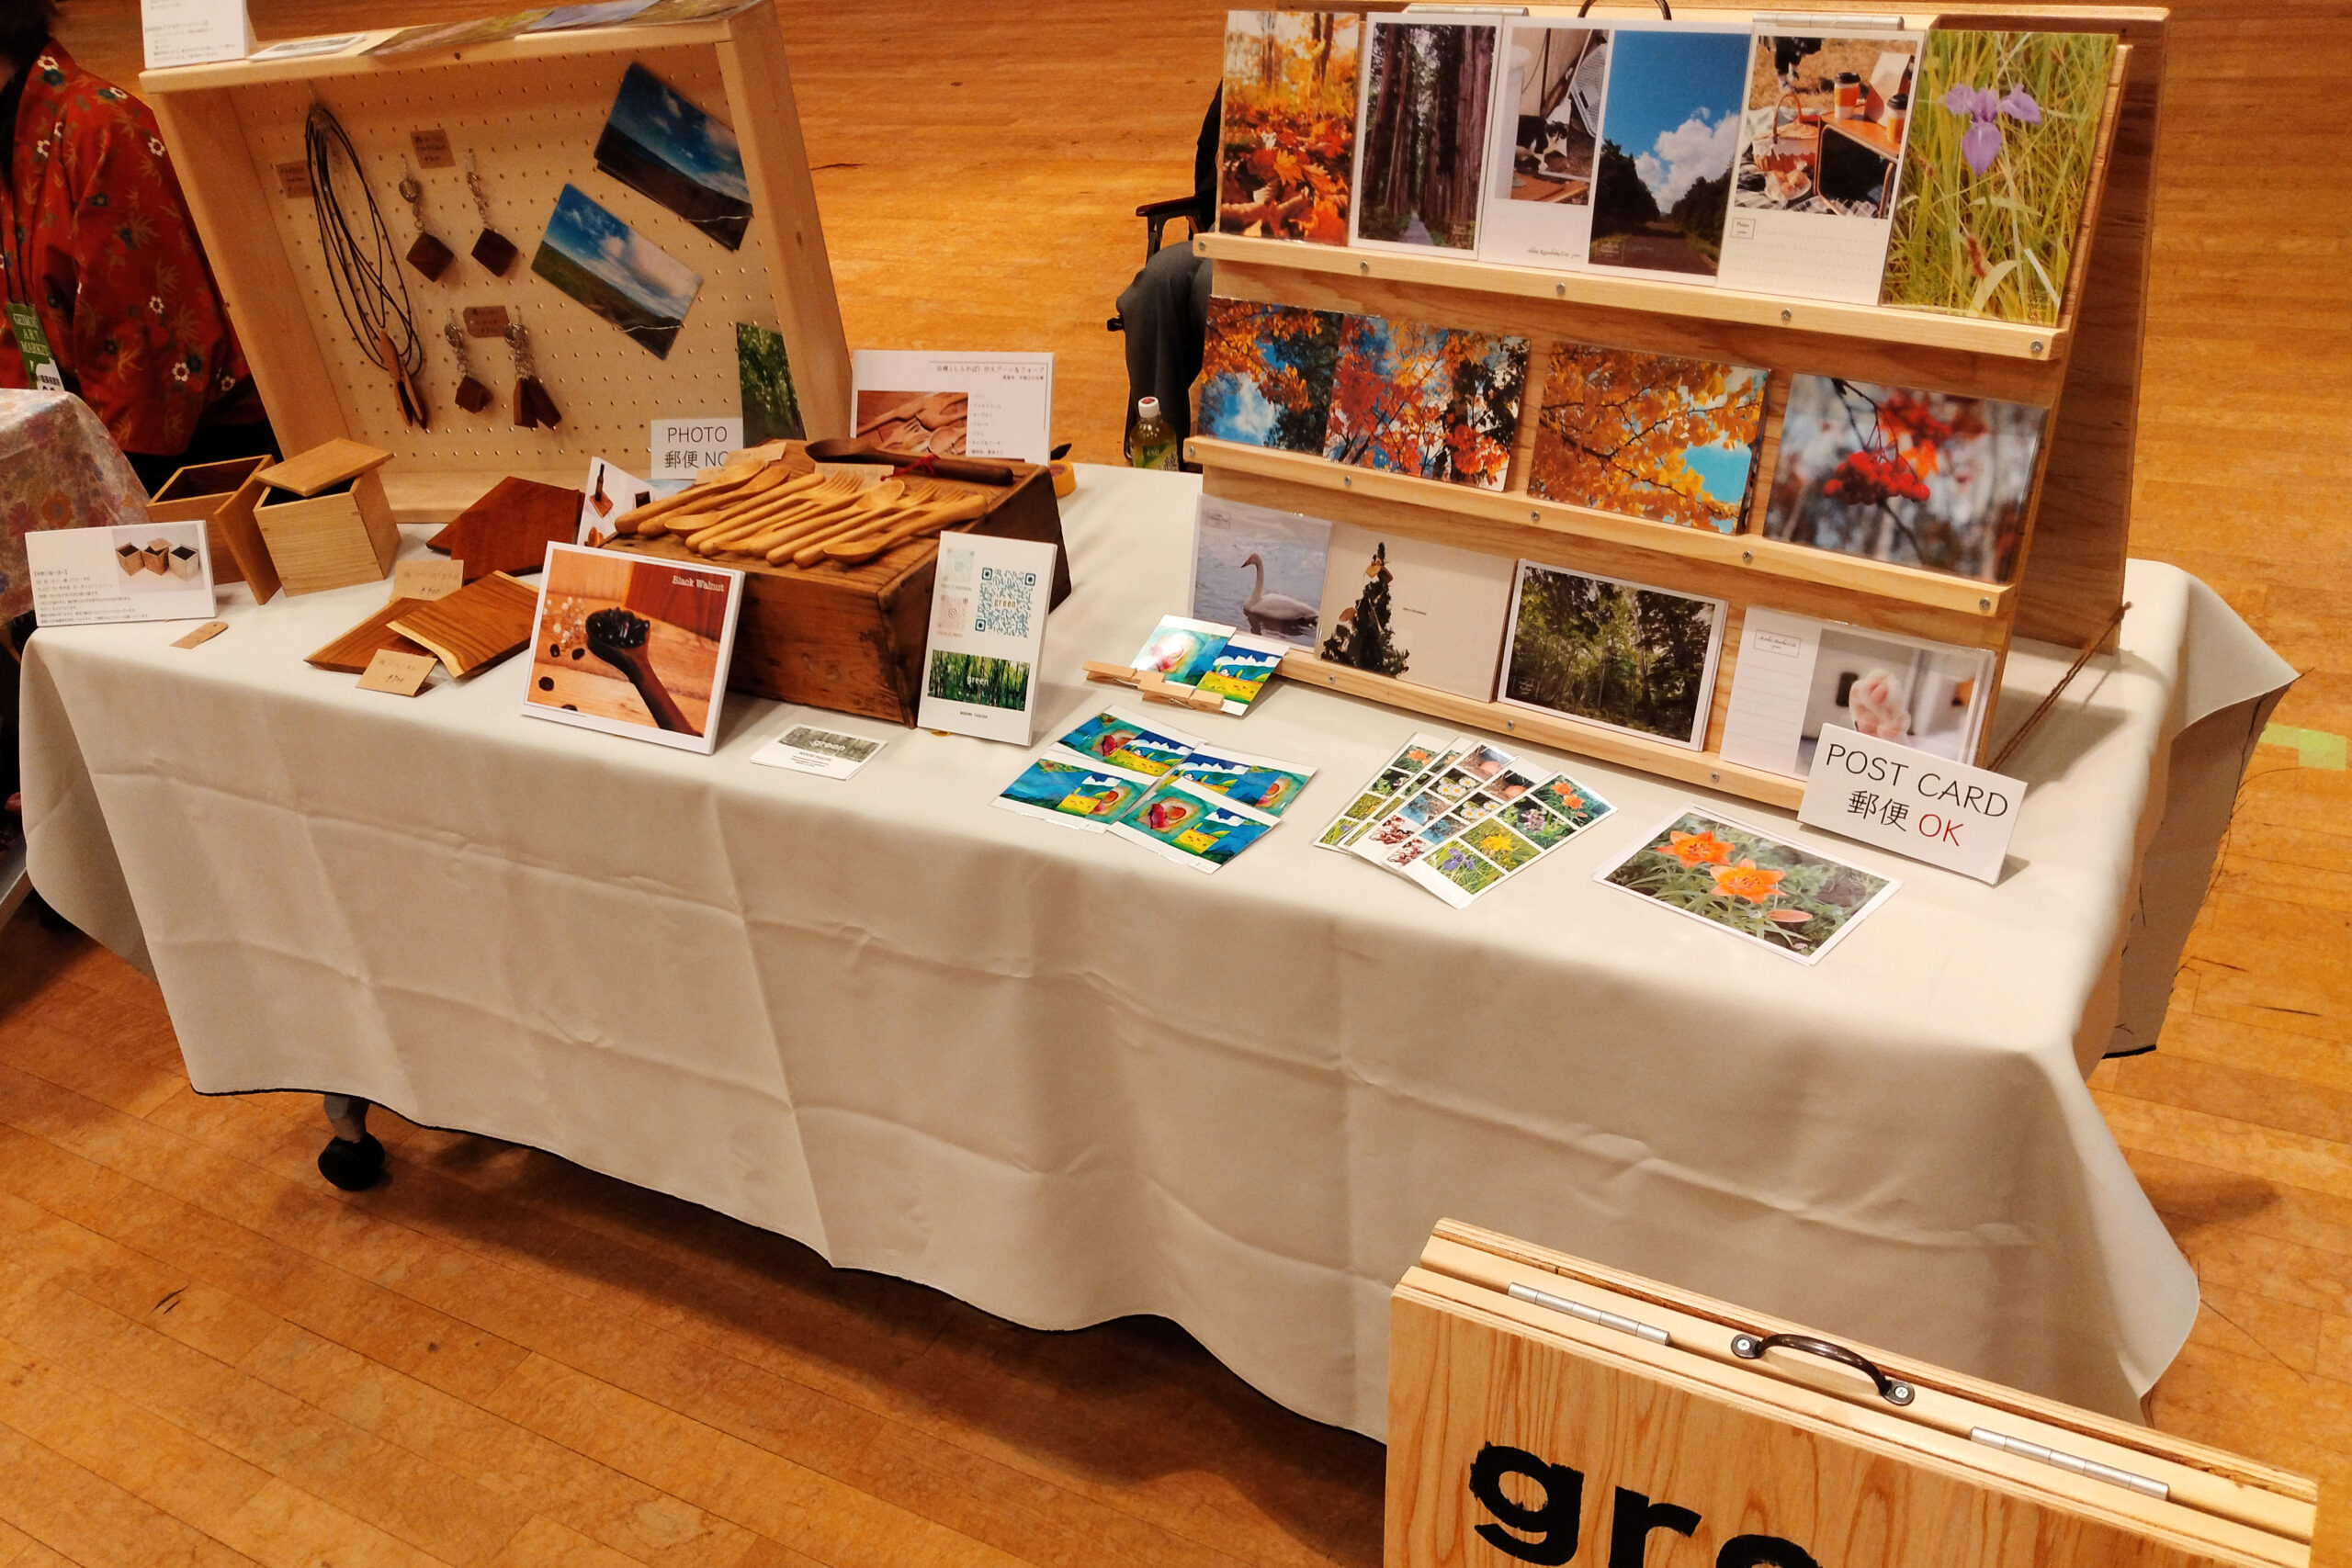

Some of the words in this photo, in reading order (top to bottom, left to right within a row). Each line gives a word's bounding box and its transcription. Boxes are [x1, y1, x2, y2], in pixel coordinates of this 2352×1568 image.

[668, 426, 728, 443] PHOTO
[664, 450, 699, 469] 郵便
[672, 575, 695, 588] Black
[696, 578, 725, 592] Walnut
[994, 598, 1016, 609] green
[967, 674, 989, 686] green
[810, 739, 846, 751] green
[1826, 743, 1909, 786] POST
[1917, 773, 2008, 818] CARD
[1847, 789, 1910, 832] 郵便
[1918, 813, 1964, 847] OK
